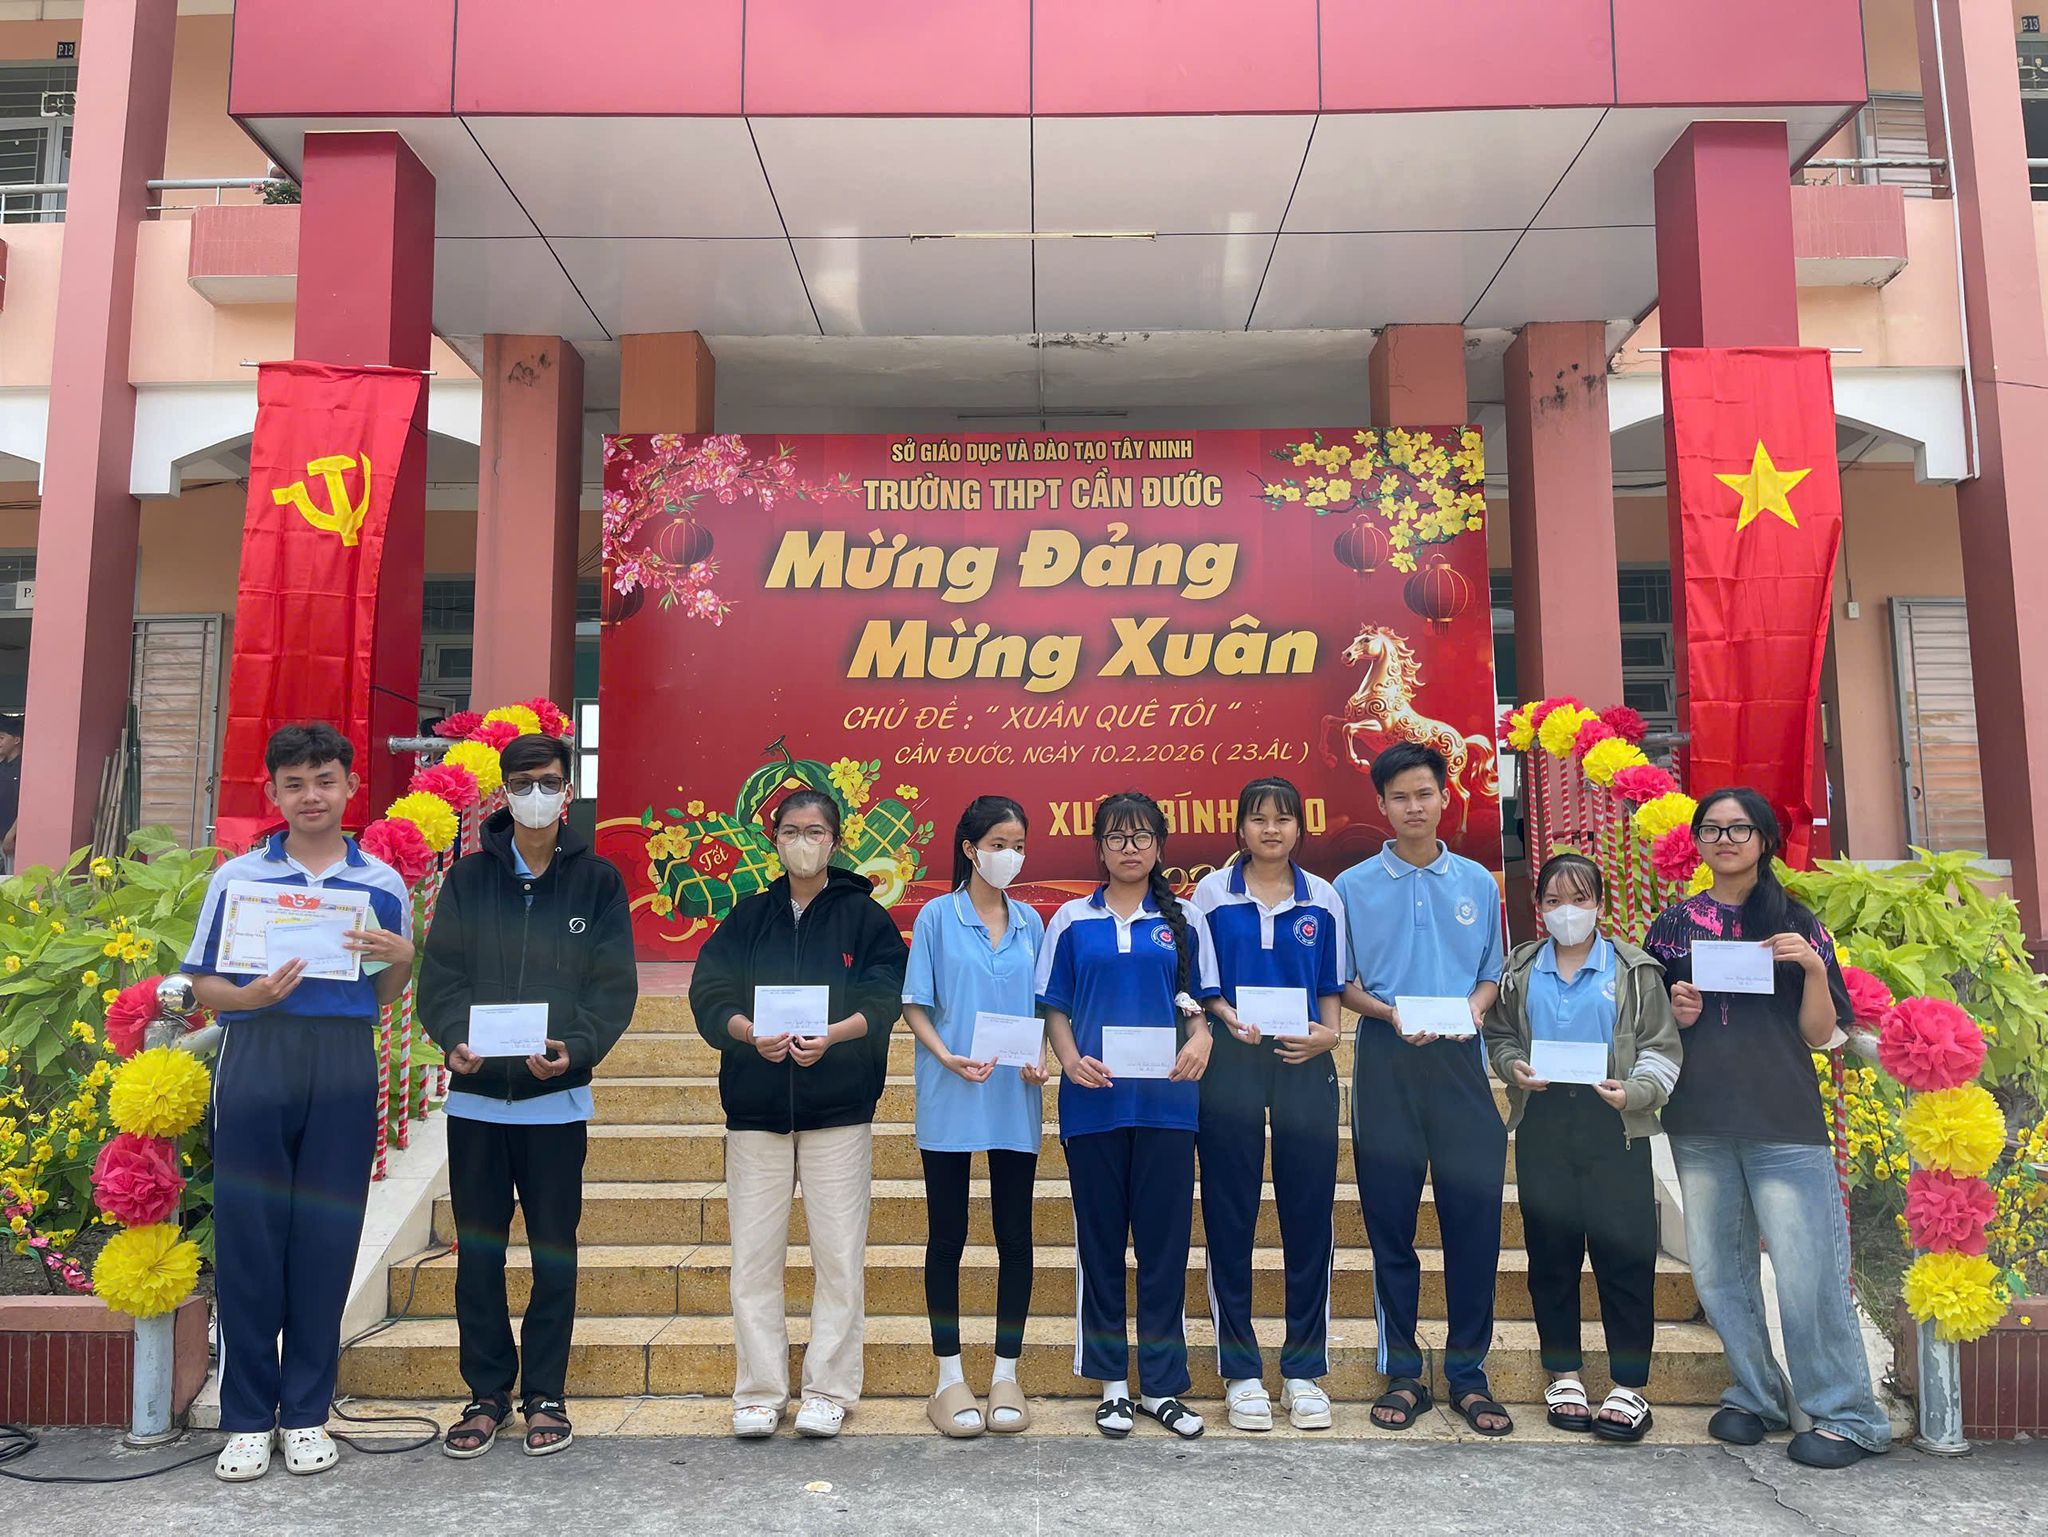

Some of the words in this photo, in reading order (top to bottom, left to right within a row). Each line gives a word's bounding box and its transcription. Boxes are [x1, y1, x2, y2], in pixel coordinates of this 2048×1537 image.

[891, 437, 916, 462] SỞ
[920, 439, 962, 462] GIÁO
[966, 442, 1002, 466] DỤC
[1006, 439, 1029, 462] VÀ
[1033, 438, 1070, 462] ĐÀO
[1074, 440, 1107, 464] TẠO
[1112, 436, 1144, 460] TÂY
[1148, 439, 1193, 460] NINH
[863, 471, 982, 511] TRƯỜNG
[989, 478, 1063, 511] THPT
[1071, 466, 1134, 509] CẦN
[1141, 469, 1223, 509] ĐƯỚC
[764, 528, 999, 604] Mừng
[1018, 521, 1239, 601] Đảng
[846, 617, 1082, 693] Mừng
[1097, 613, 1319, 677] Xuân
[843, 698, 909, 730] CHỦ
[914, 695, 959, 730] ĐỀ
[1001, 699, 1089, 730] XUÂN
[1095, 697, 1160, 732] QUÊ
[1168, 697, 1218, 728] TÔI
[894, 738, 943, 765] CẦN
[946, 740, 1016, 766] ĐƯỚC,
[1022, 740, 1085, 765] NGÀY
[1091, 743, 1205, 763] 10.2.2026
[699, 844, 729, 872] Tết
